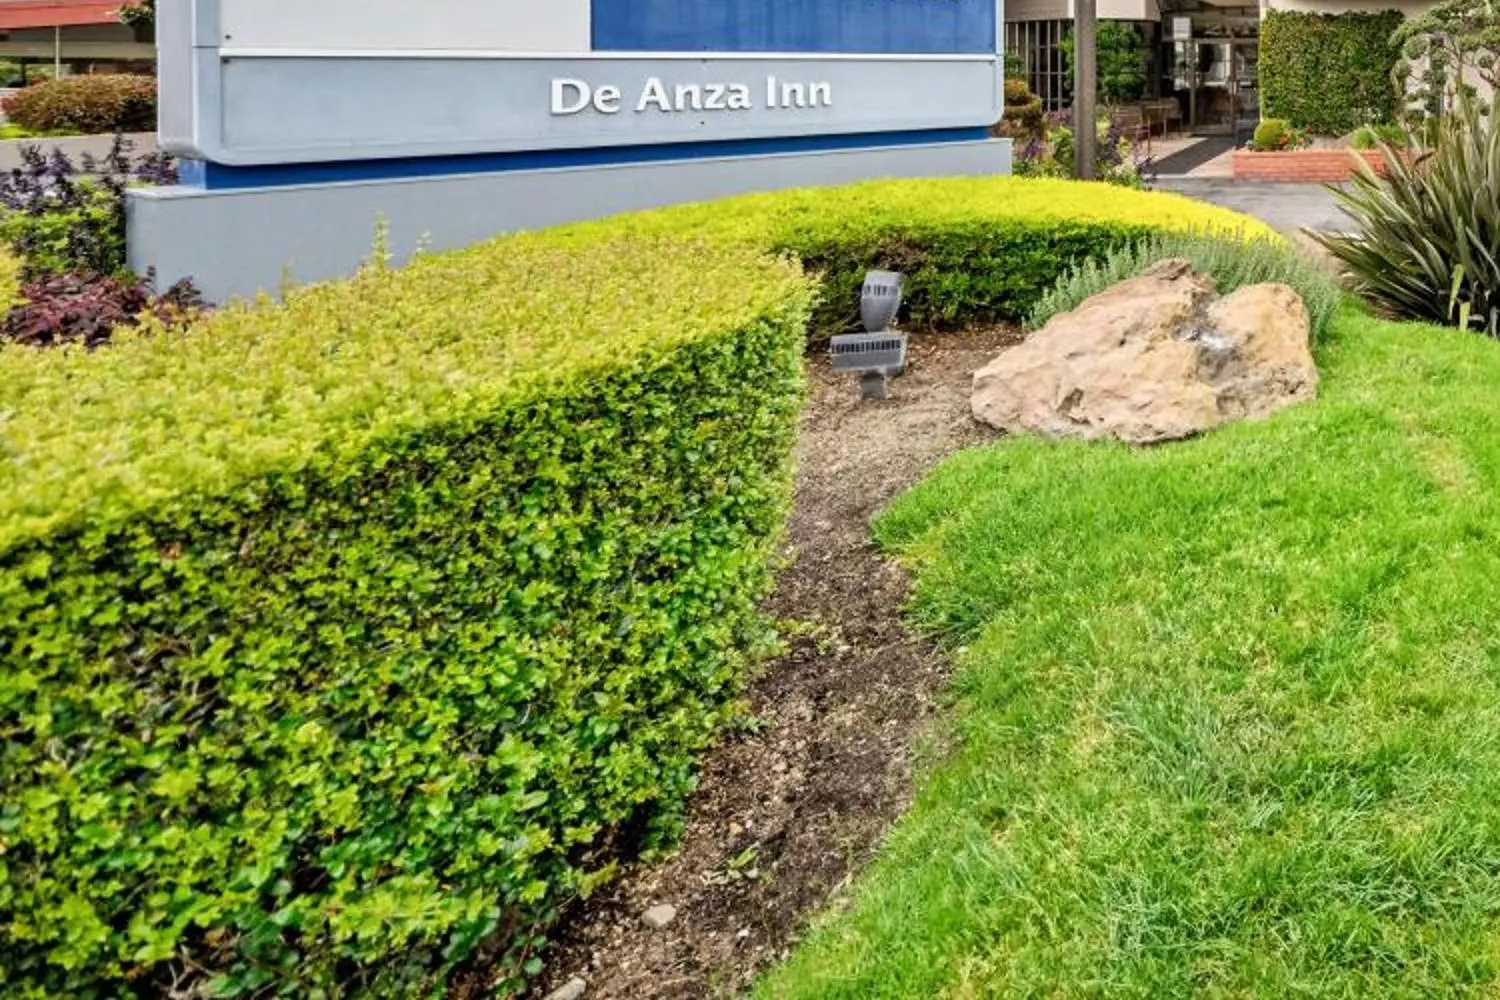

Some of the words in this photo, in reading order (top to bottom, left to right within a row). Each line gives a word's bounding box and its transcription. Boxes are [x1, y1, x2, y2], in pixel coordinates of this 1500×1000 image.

[550, 77, 621, 114] De
[635, 76, 751, 110] Anza
[766, 75, 832, 106] Inn
